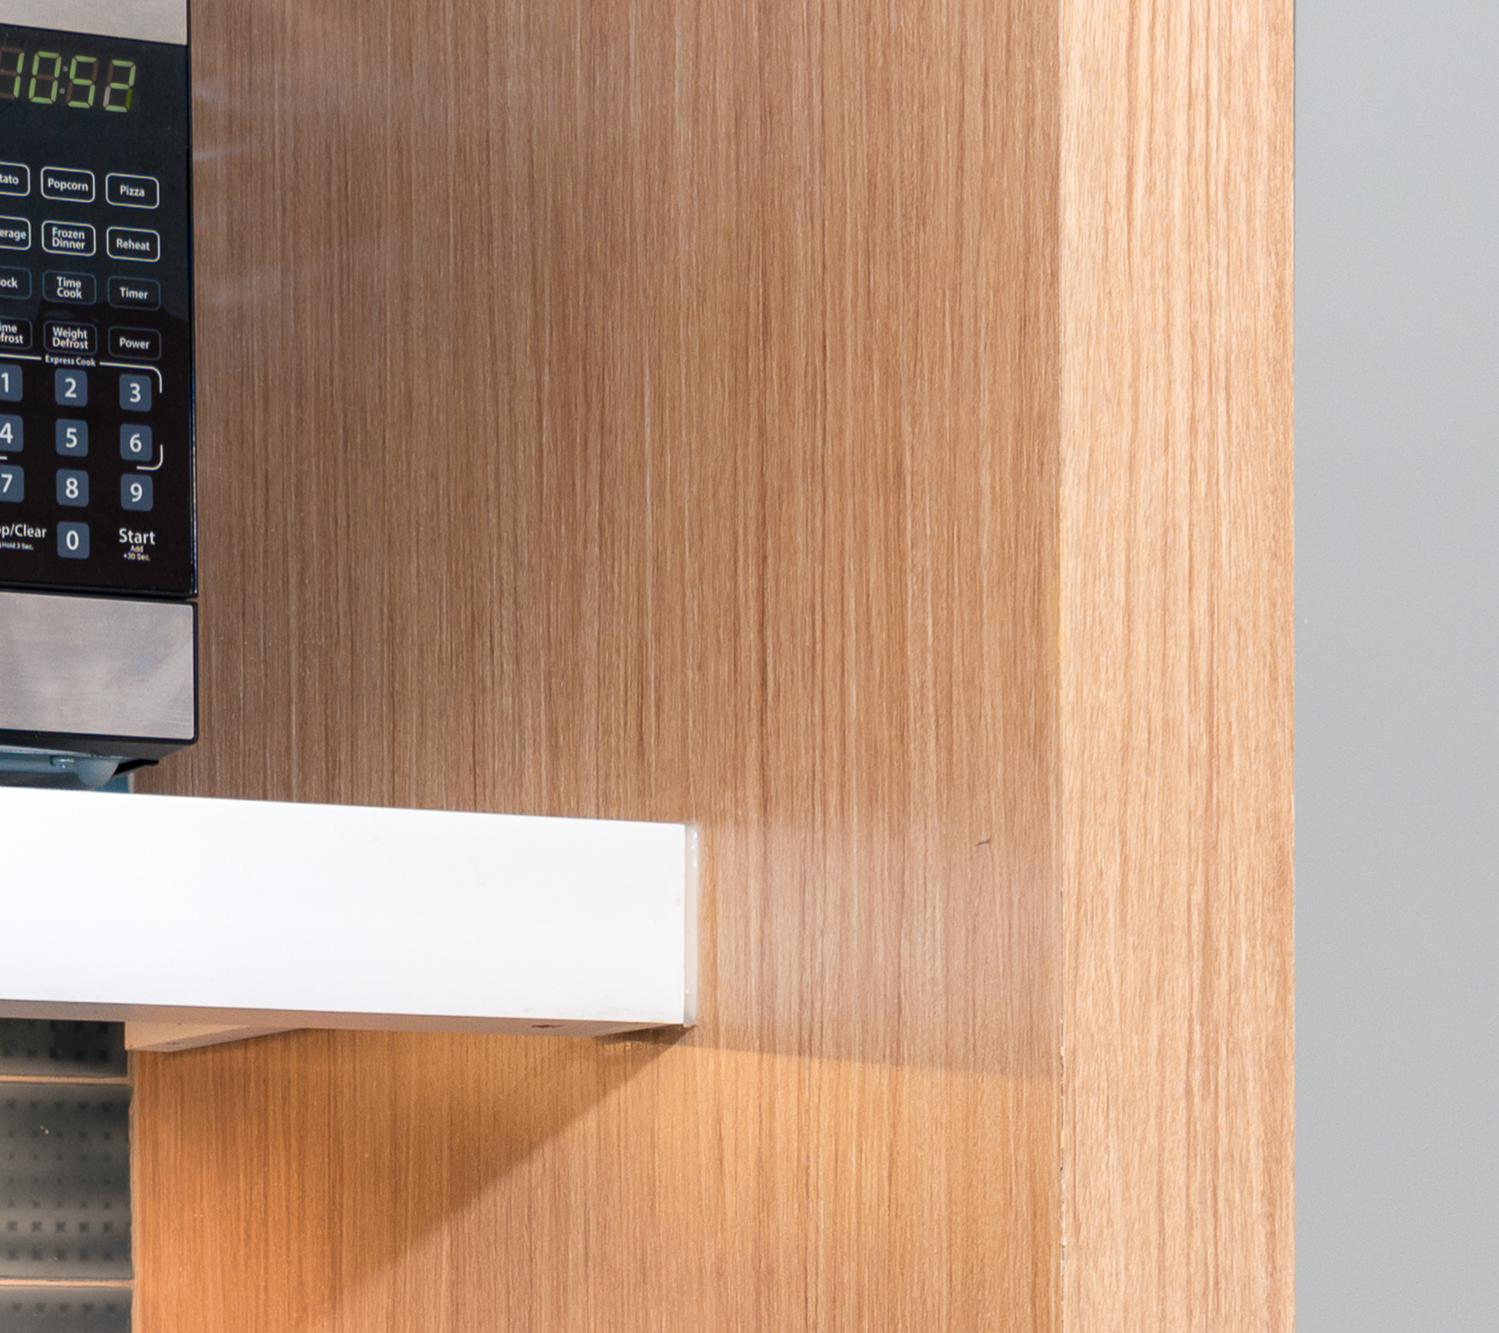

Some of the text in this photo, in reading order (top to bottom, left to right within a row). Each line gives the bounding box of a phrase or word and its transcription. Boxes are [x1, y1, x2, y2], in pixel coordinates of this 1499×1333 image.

[47, 177, 89, 192] Popcorn
[119, 184, 145, 197] Pizza
[52, 226, 85, 240] Frozen
[52, 237, 86, 250] Dinner
[116, 238, 150, 251] Reheat
[56, 276, 82, 288] Time
[56, 287, 82, 299] Cook
[119, 286, 149, 300] Timer
[52, 326, 88, 340] Weight
[52, 337, 89, 350] Defrost
[119, 336, 150, 349] Power
[45, 354, 96, 367] Express Cook
[0, 372, 9, 393] 1
[64, 377, 77, 398] 2
[129, 382, 142, 403] 3
[65, 427, 78, 448] 5
[129, 433, 142, 453] 6
[0, 473, 14, 493] 7
[65, 477, 79, 499] 8
[129, 482, 143, 503] 9
[66, 530, 79, 551] 0
[118, 527, 156, 545] Start
